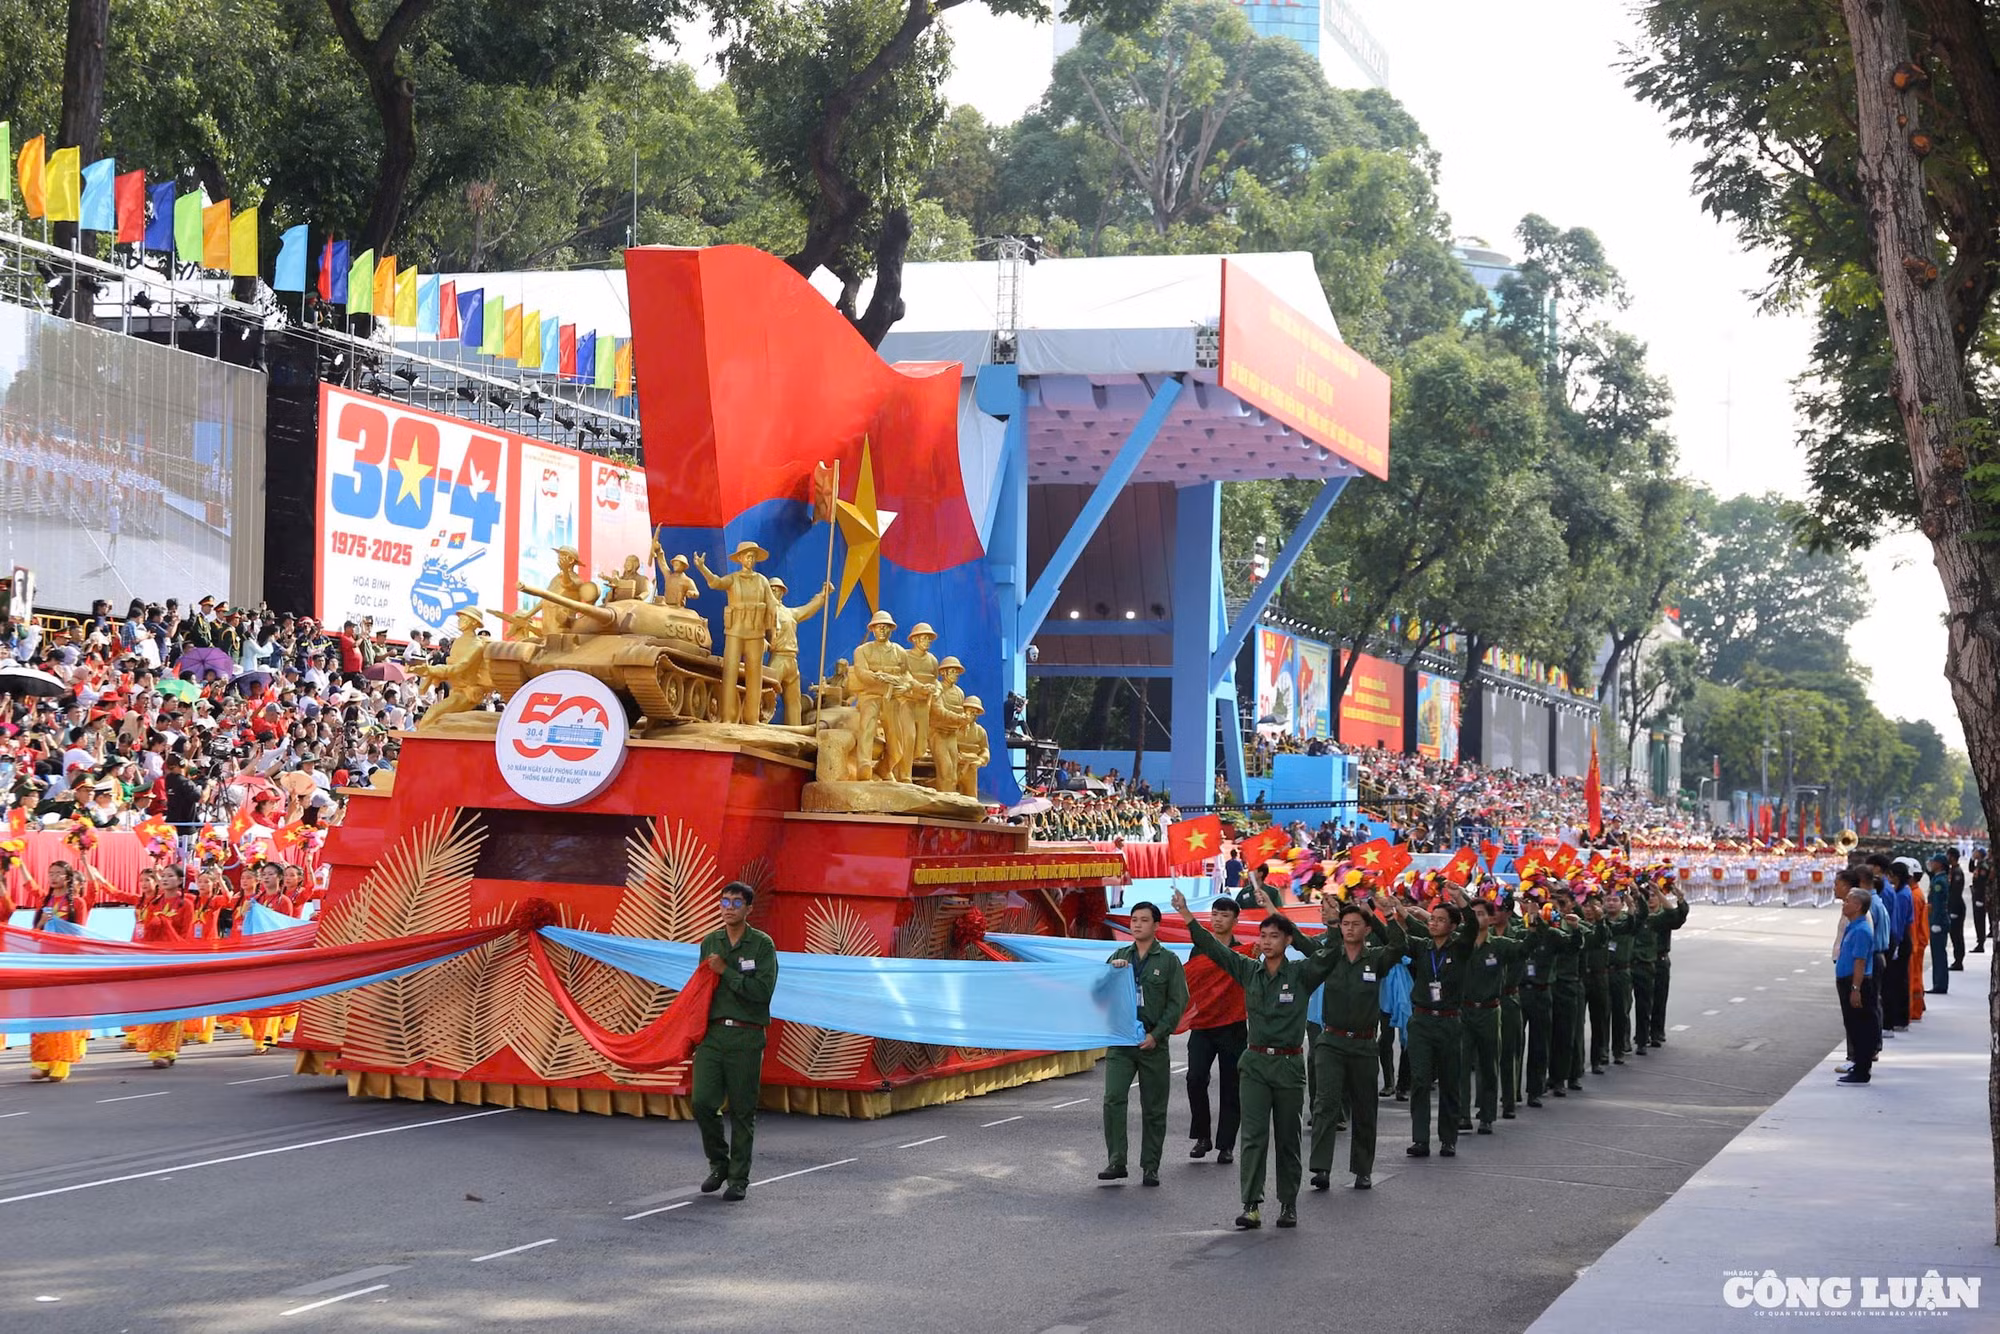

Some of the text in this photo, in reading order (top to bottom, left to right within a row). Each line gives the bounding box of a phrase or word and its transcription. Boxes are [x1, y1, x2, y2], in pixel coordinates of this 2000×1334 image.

[665, 622, 695, 641] 390
[512, 692, 609, 762] 50
[526, 727, 543, 737] 30.4
